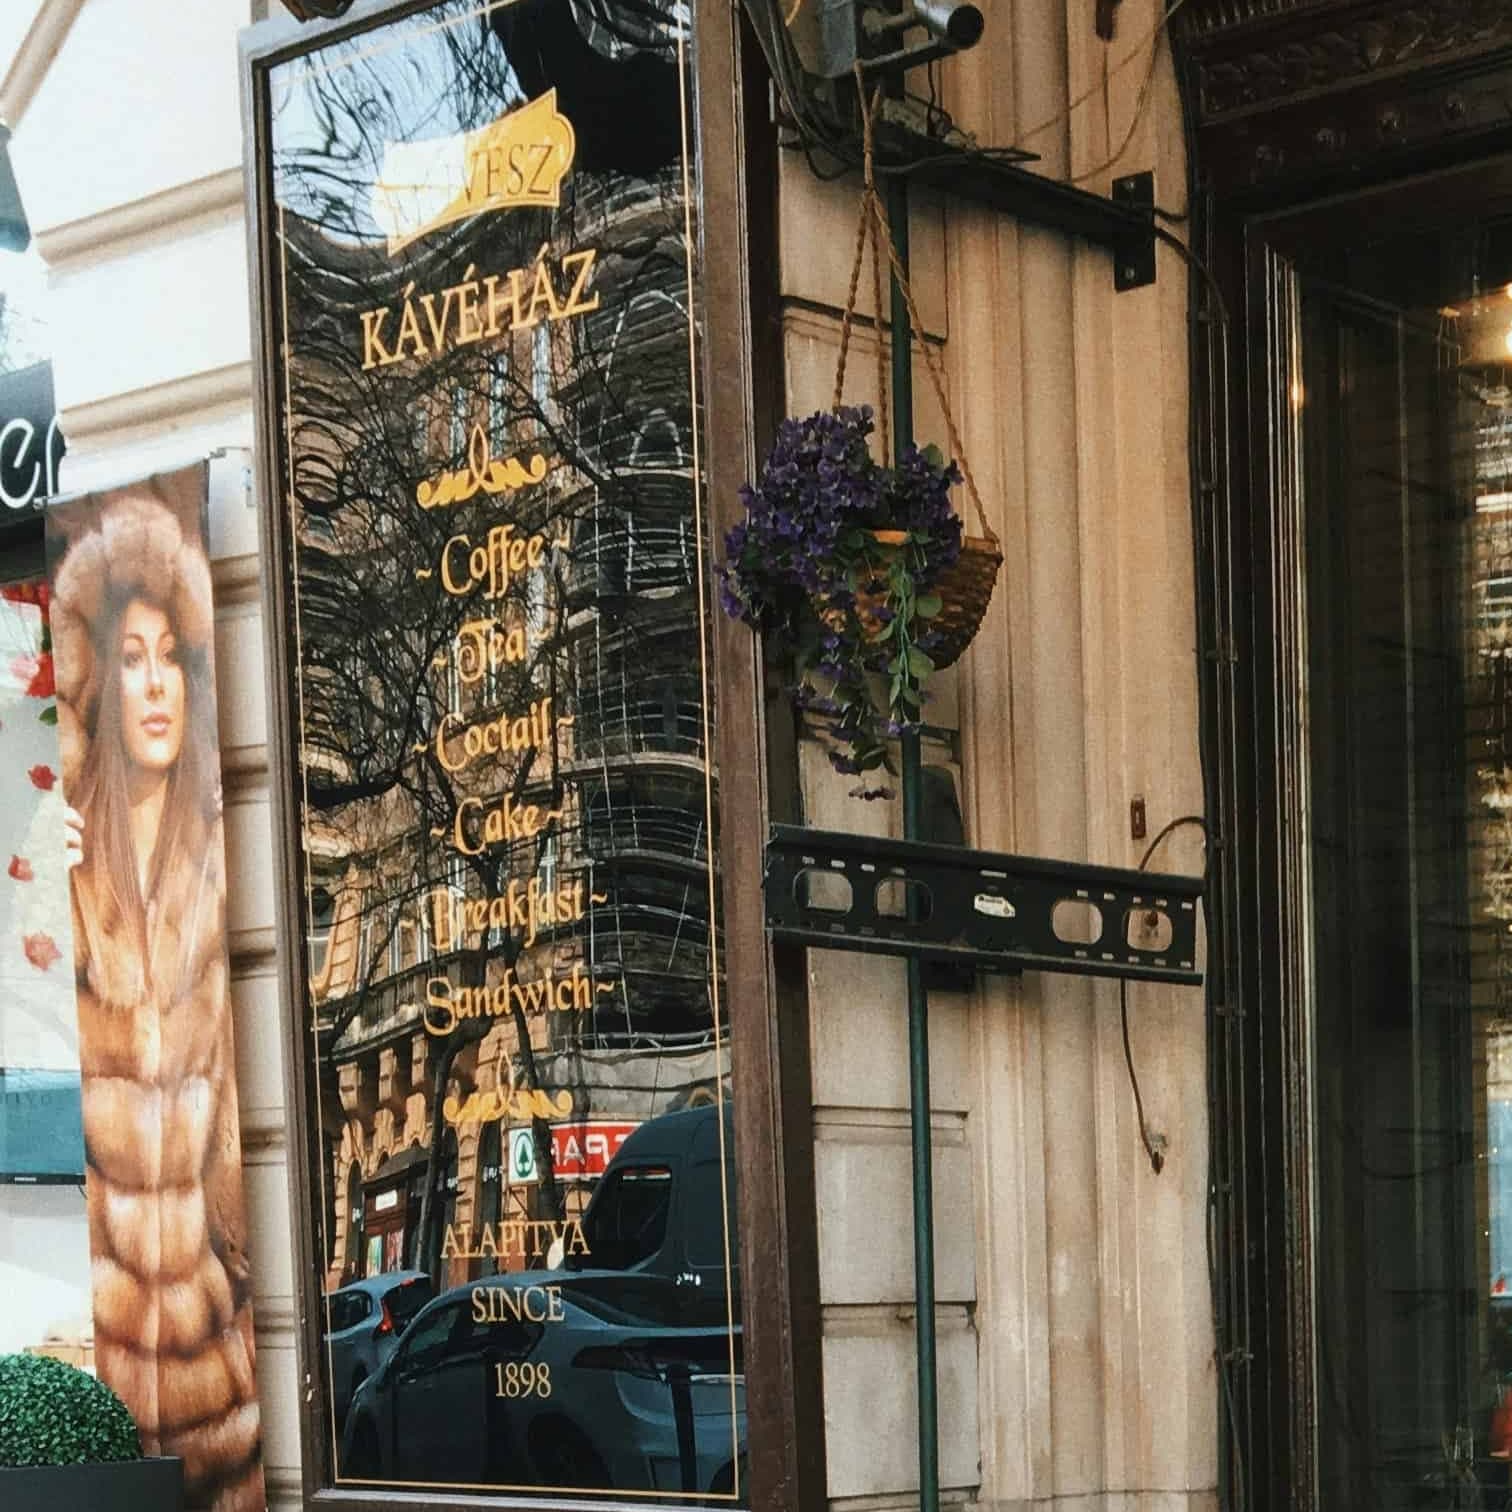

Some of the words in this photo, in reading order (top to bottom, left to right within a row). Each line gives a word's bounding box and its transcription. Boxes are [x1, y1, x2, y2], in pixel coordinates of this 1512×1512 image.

[360, 243, 600, 370] KÁVÉHÁZ
[441, 524, 543, 599] Coffee
[457, 617, 525, 683] Tea
[454, 793, 538, 856] Cake
[426, 877, 586, 951] Breakfast
[424, 964, 593, 1036] Sandwich
[471, 1287, 565, 1323] SINCE
[495, 1362, 551, 1398] 1898
